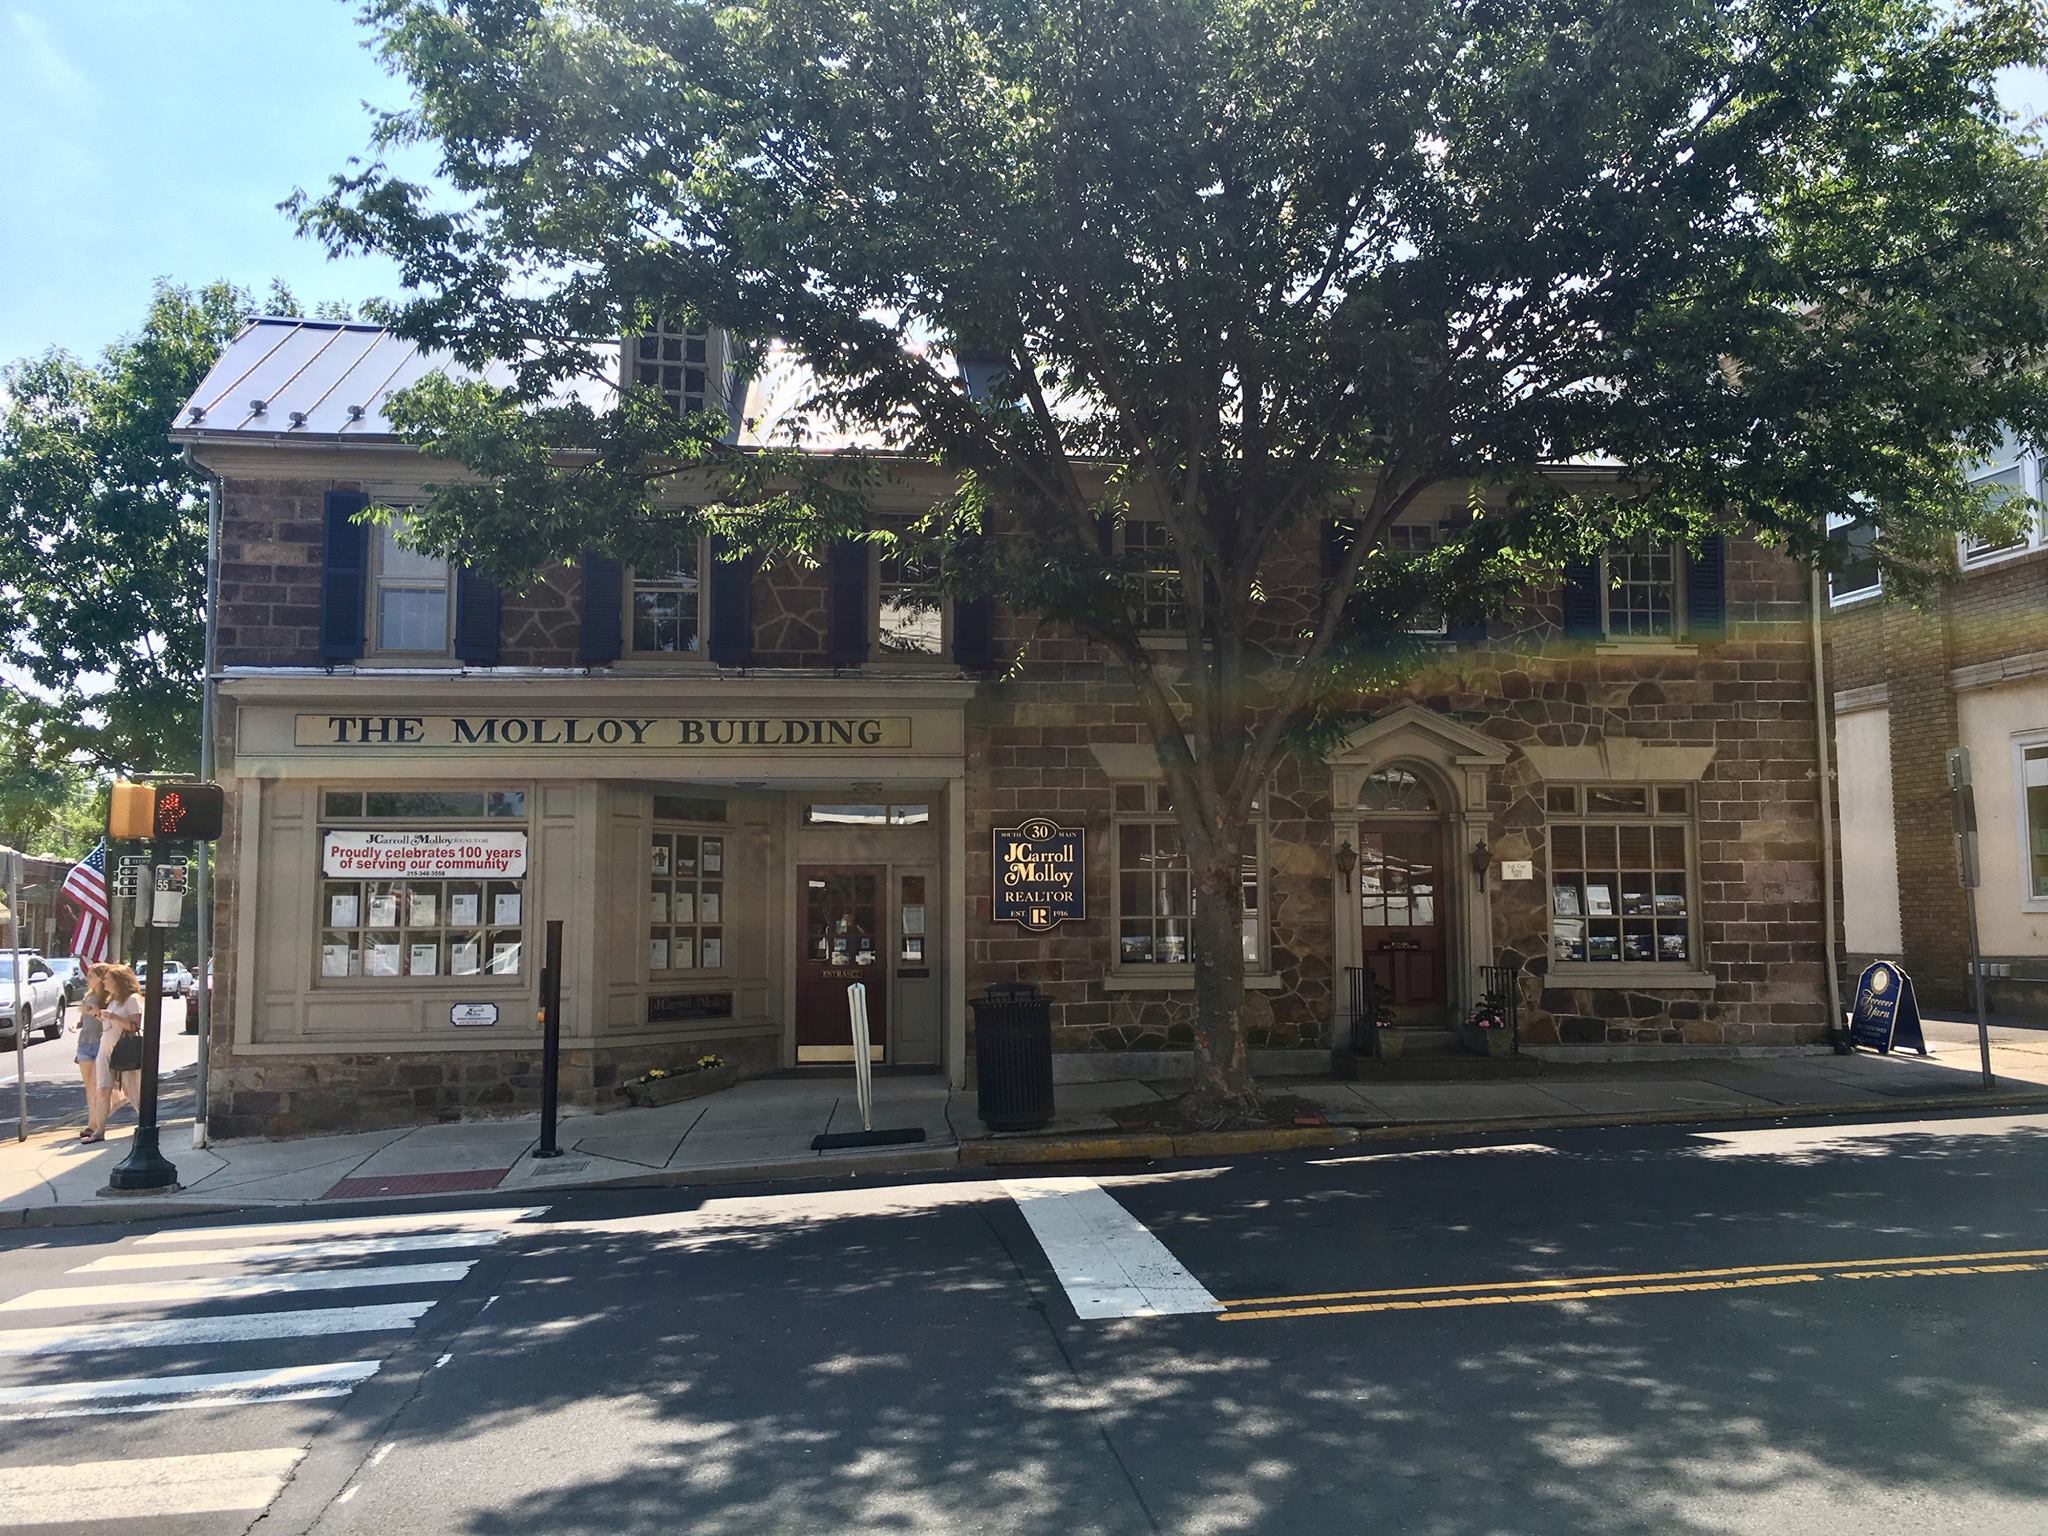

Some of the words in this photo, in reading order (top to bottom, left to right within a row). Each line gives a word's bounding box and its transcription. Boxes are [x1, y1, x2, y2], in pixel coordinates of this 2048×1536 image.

[329, 716, 425, 743] THE
[452, 717, 657, 744] MOLLOY
[678, 719, 884, 745] BUILDING
[1031, 825, 1048, 838] 30
[410, 834, 453, 847] Molloy
[331, 845, 381, 860] Proudly
[385, 846, 456, 859] celebrates
[459, 846, 482, 858] 100
[486, 848, 522, 861] years
[339, 858, 353, 869] of
[355, 858, 406, 872] serving
[410, 860, 432, 869] our
[435, 858, 509, 872] community
[1004, 862, 1074, 888] Molloy
[157, 879, 169, 891] 55
[1005, 891, 1074, 902] REALTOR
[1863, 1004, 1890, 1021] Yarn
